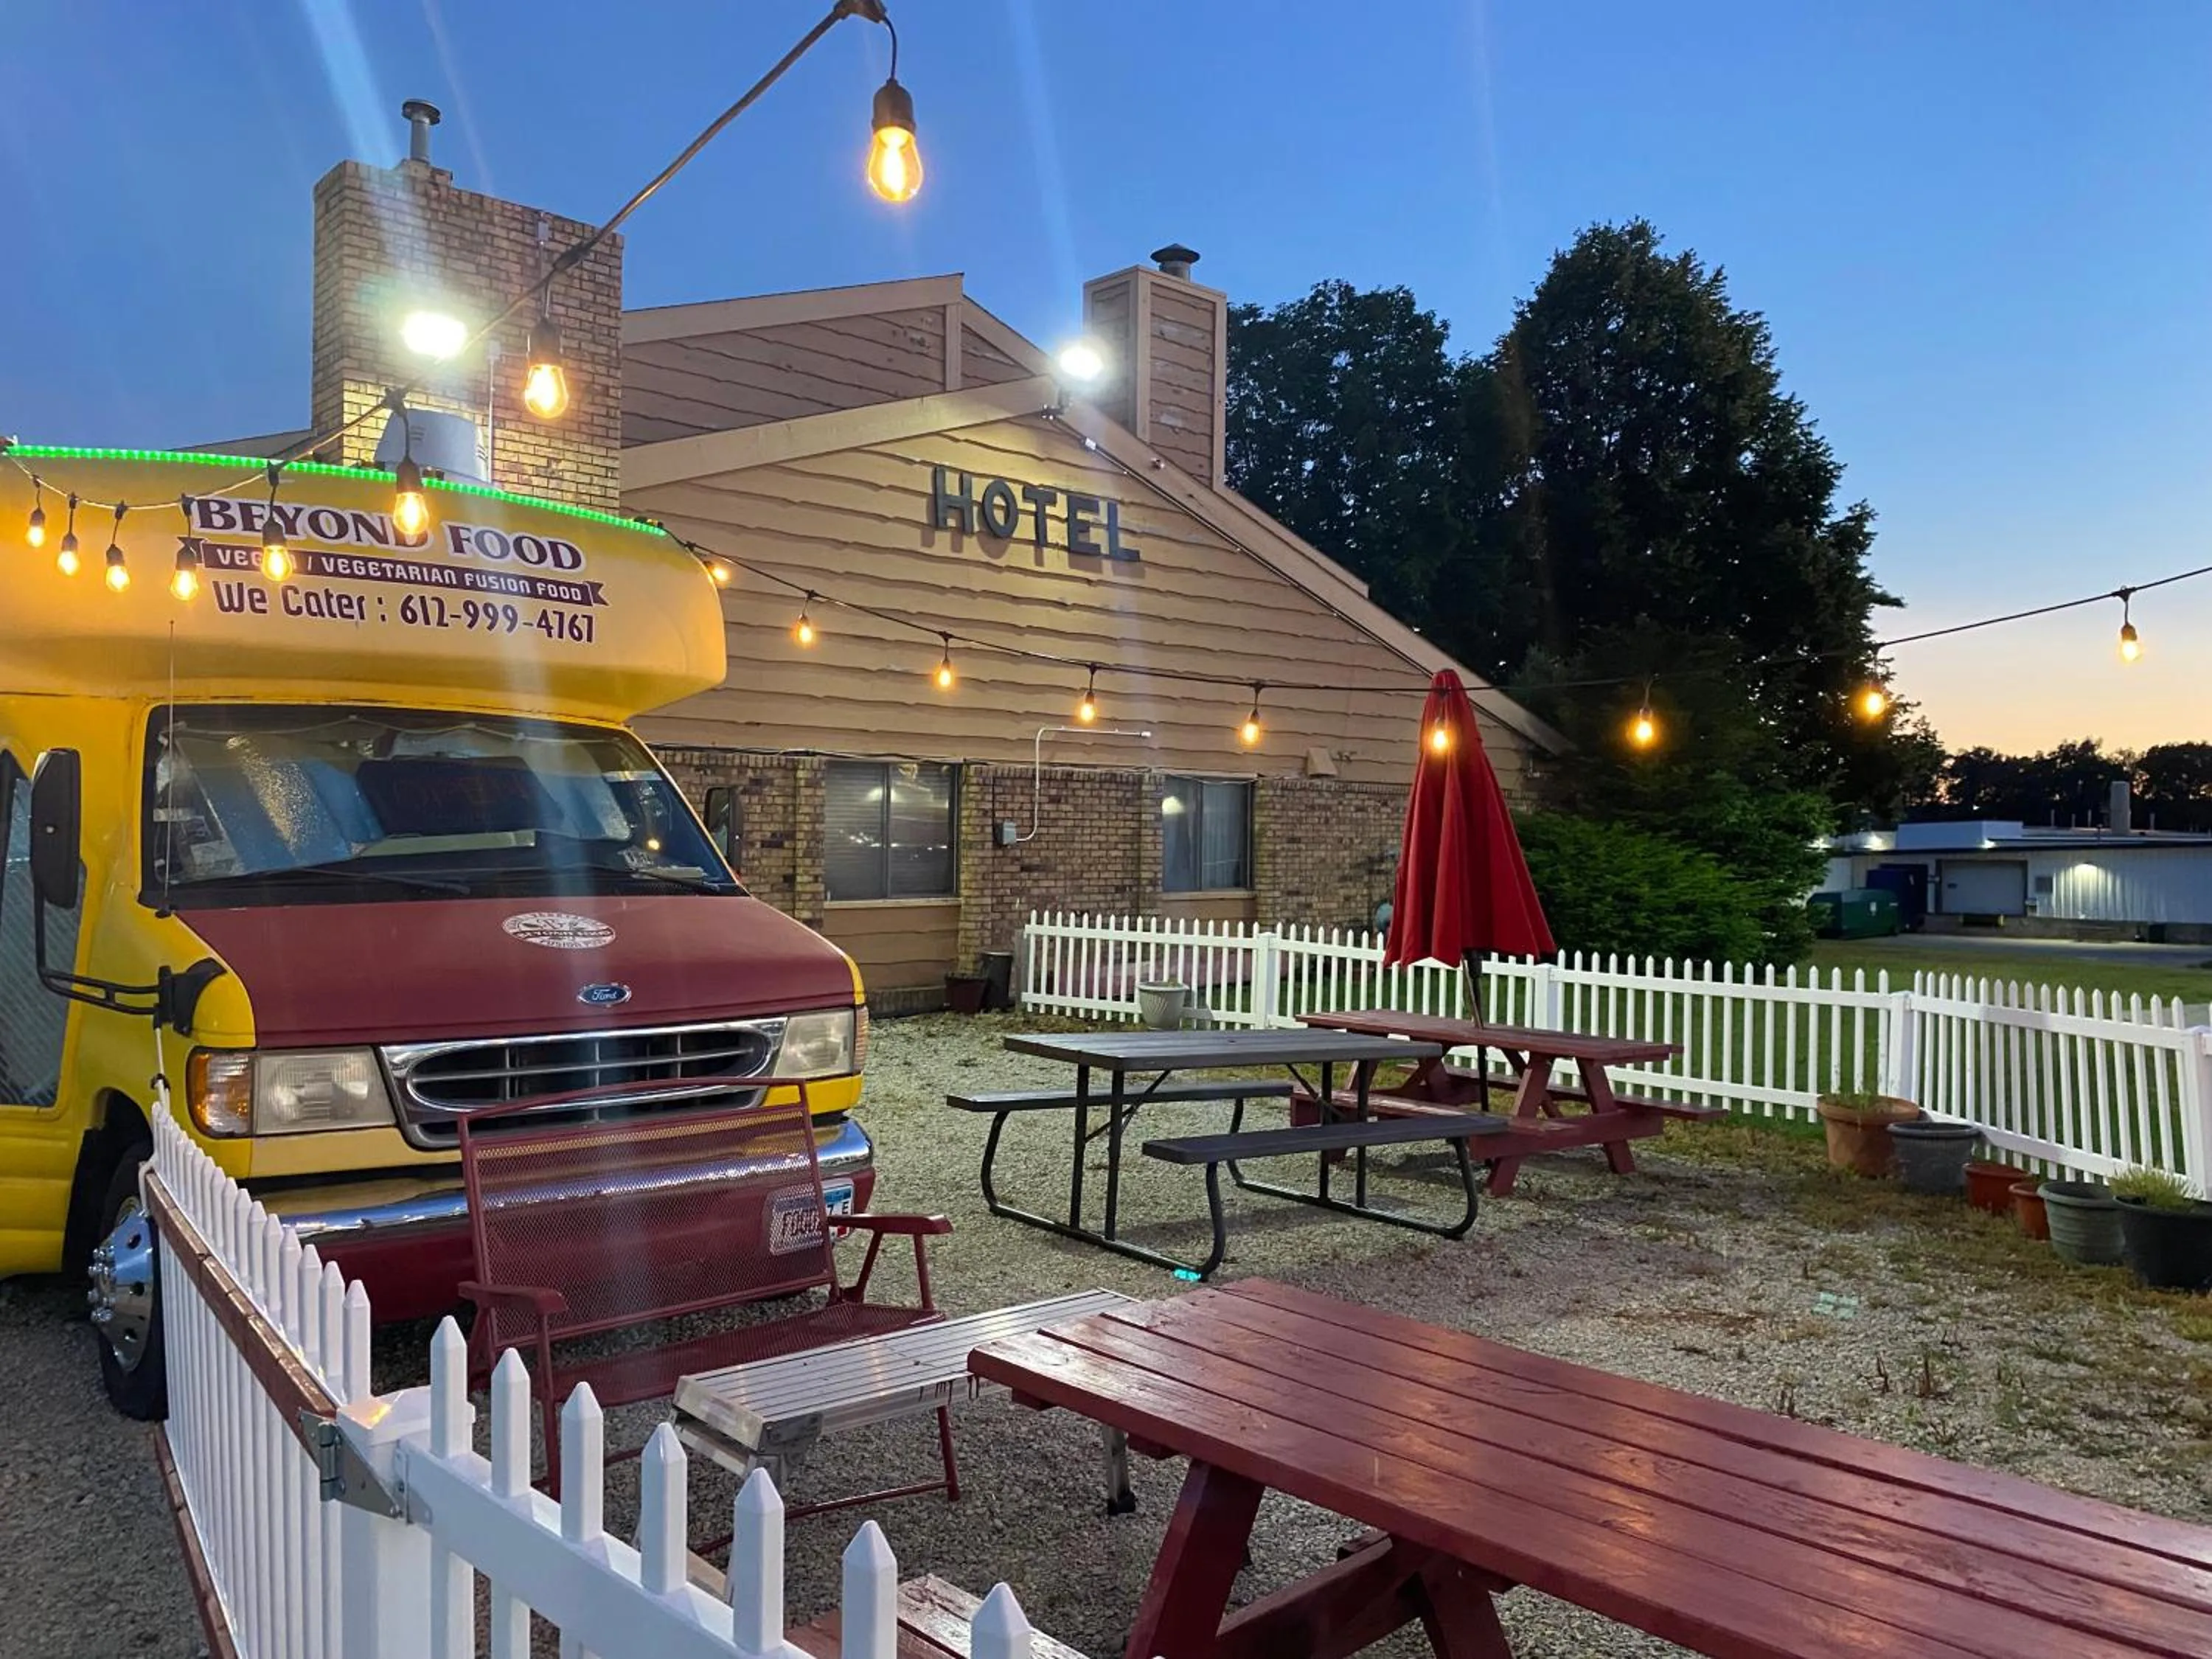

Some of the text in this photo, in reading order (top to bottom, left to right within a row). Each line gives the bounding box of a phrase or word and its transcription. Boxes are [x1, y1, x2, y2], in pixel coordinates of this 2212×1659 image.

[933, 466, 1141, 562] HOTEL
[216, 548, 298, 573] VEG
[321, 556, 457, 585] VEGETARIAN
[464, 572, 531, 594] FUSION
[536, 582, 582, 601] FOOD
[448, 524, 582, 569] FOOD
[212, 580, 268, 614] We
[282, 585, 365, 620] Cater
[400, 594, 594, 643] 612-999-4767
